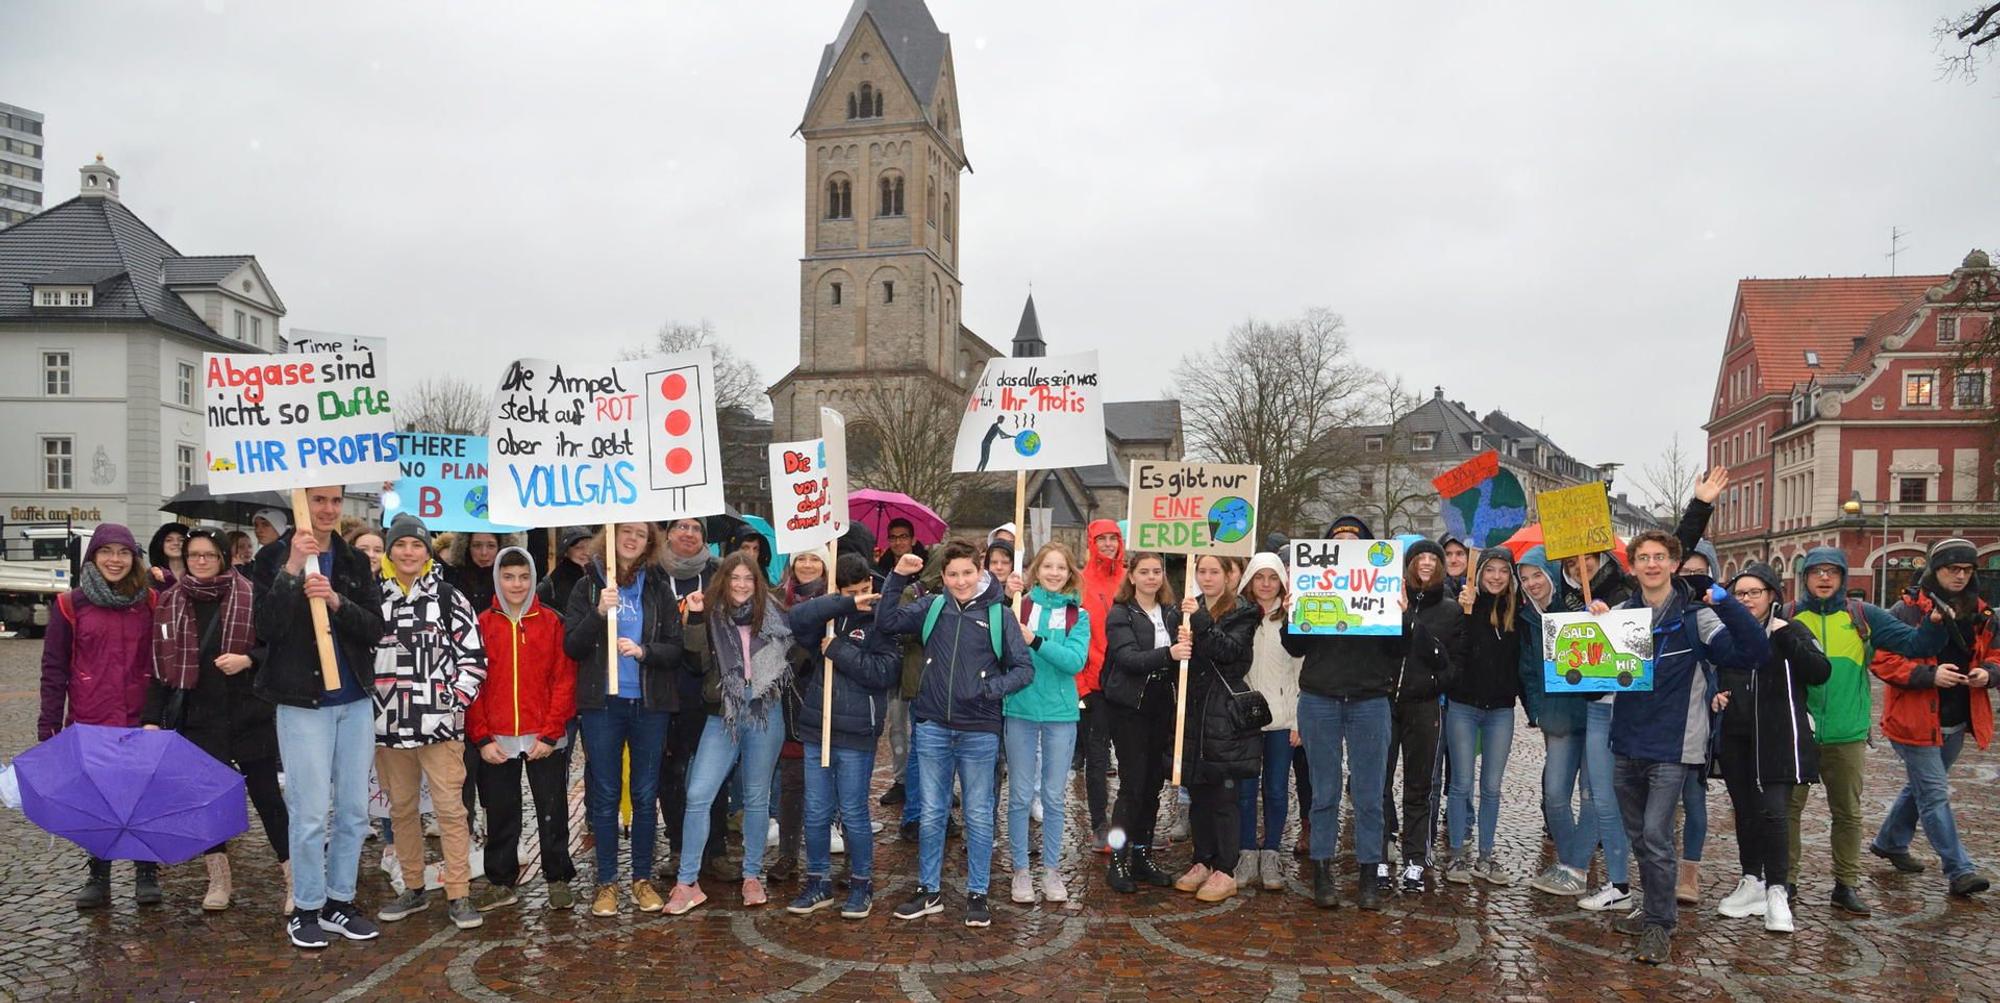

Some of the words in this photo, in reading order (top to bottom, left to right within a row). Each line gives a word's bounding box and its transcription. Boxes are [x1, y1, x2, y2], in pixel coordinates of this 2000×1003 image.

[293, 338, 342, 353] Time
[207, 357, 314, 403] Abgase
[321, 351, 375, 383] sind
[501, 360, 534, 391] Die
[547, 364, 626, 403] Ampel
[997, 370, 1017, 387] das
[1018, 367, 1049, 388] alles
[1050, 370, 1075, 387] sein
[1077, 373, 1097, 387] was
[208, 393, 270, 427] nicht
[278, 403, 309, 424] so
[498, 394, 550, 424] steht
[555, 398, 585, 425] auf
[595, 394, 639, 421] ROT
[1001, 387, 1027, 411] Ihr
[1029, 384, 1085, 412] Profis
[235, 440, 288, 474] IHR
[297, 431, 399, 468] PROFIS
[396, 434, 466, 457] THERE
[497, 427, 542, 456] aber
[555, 430, 583, 457] ihr
[587, 428, 634, 459] gebt
[399, 461, 425, 477] NO
[441, 462, 488, 480] PLAN
[783, 450, 811, 475] Die
[508, 460, 637, 508] VOLLGAS
[793, 480, 818, 495] von
[1140, 465, 1164, 489] Es
[1168, 467, 1208, 497] gibt
[1212, 474, 1247, 488] nur
[419, 485, 443, 518] B
[1153, 496, 1204, 519] EINE
[1140, 521, 1217, 547] ERDE!
[1296, 543, 1340, 568] Bald
[1296, 568, 1400, 593] erSaUVen
